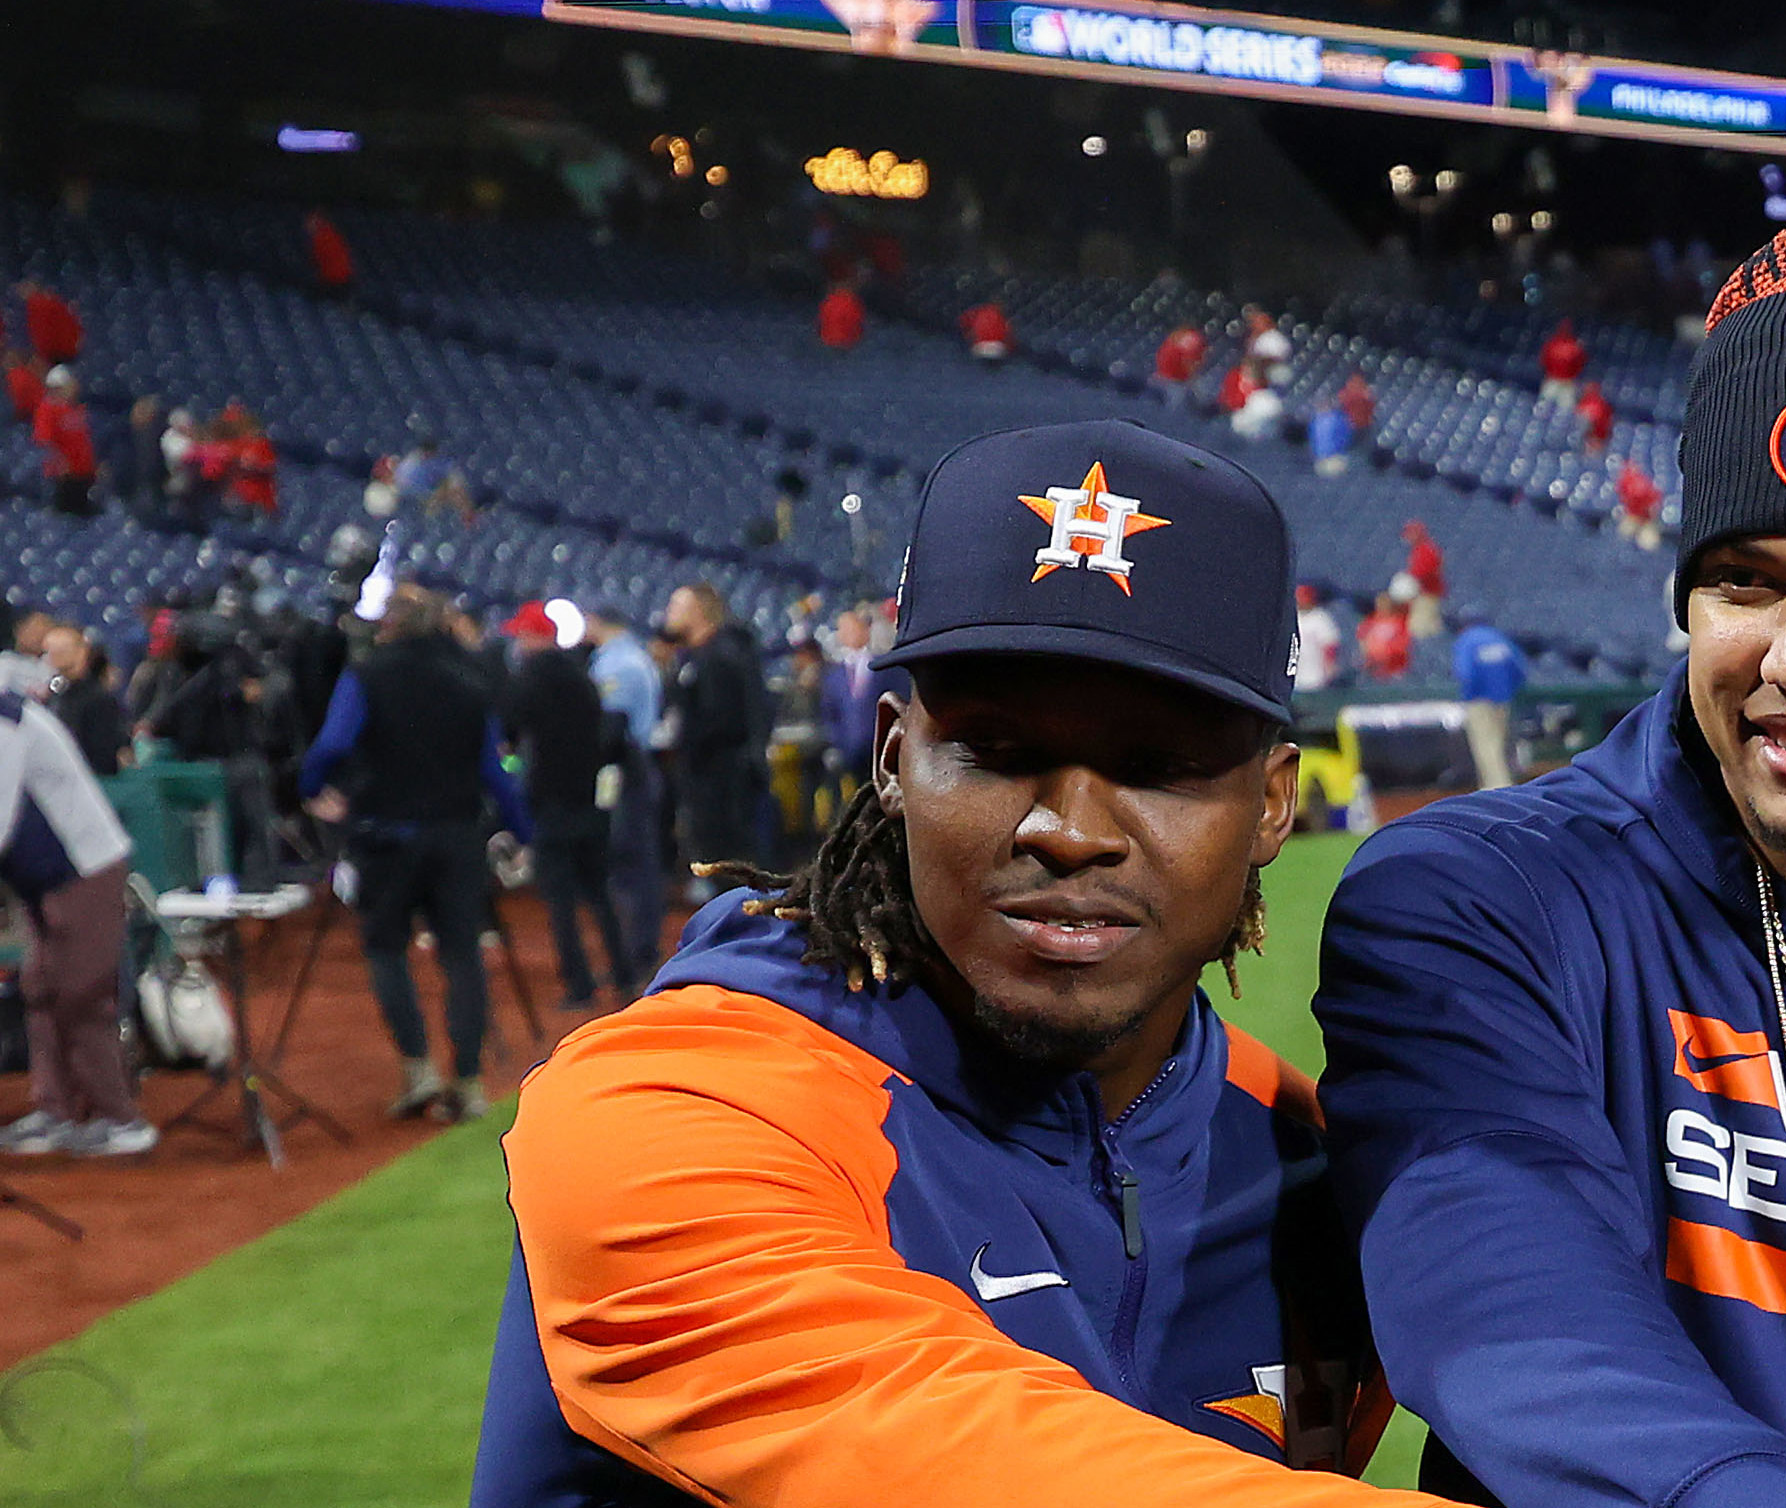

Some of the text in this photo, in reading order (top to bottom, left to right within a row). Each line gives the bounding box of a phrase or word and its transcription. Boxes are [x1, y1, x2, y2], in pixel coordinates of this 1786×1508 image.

[1065, 19, 1197, 71] WORLD
[1199, 26, 1322, 87] SERIES
[1035, 486, 1141, 576] H
